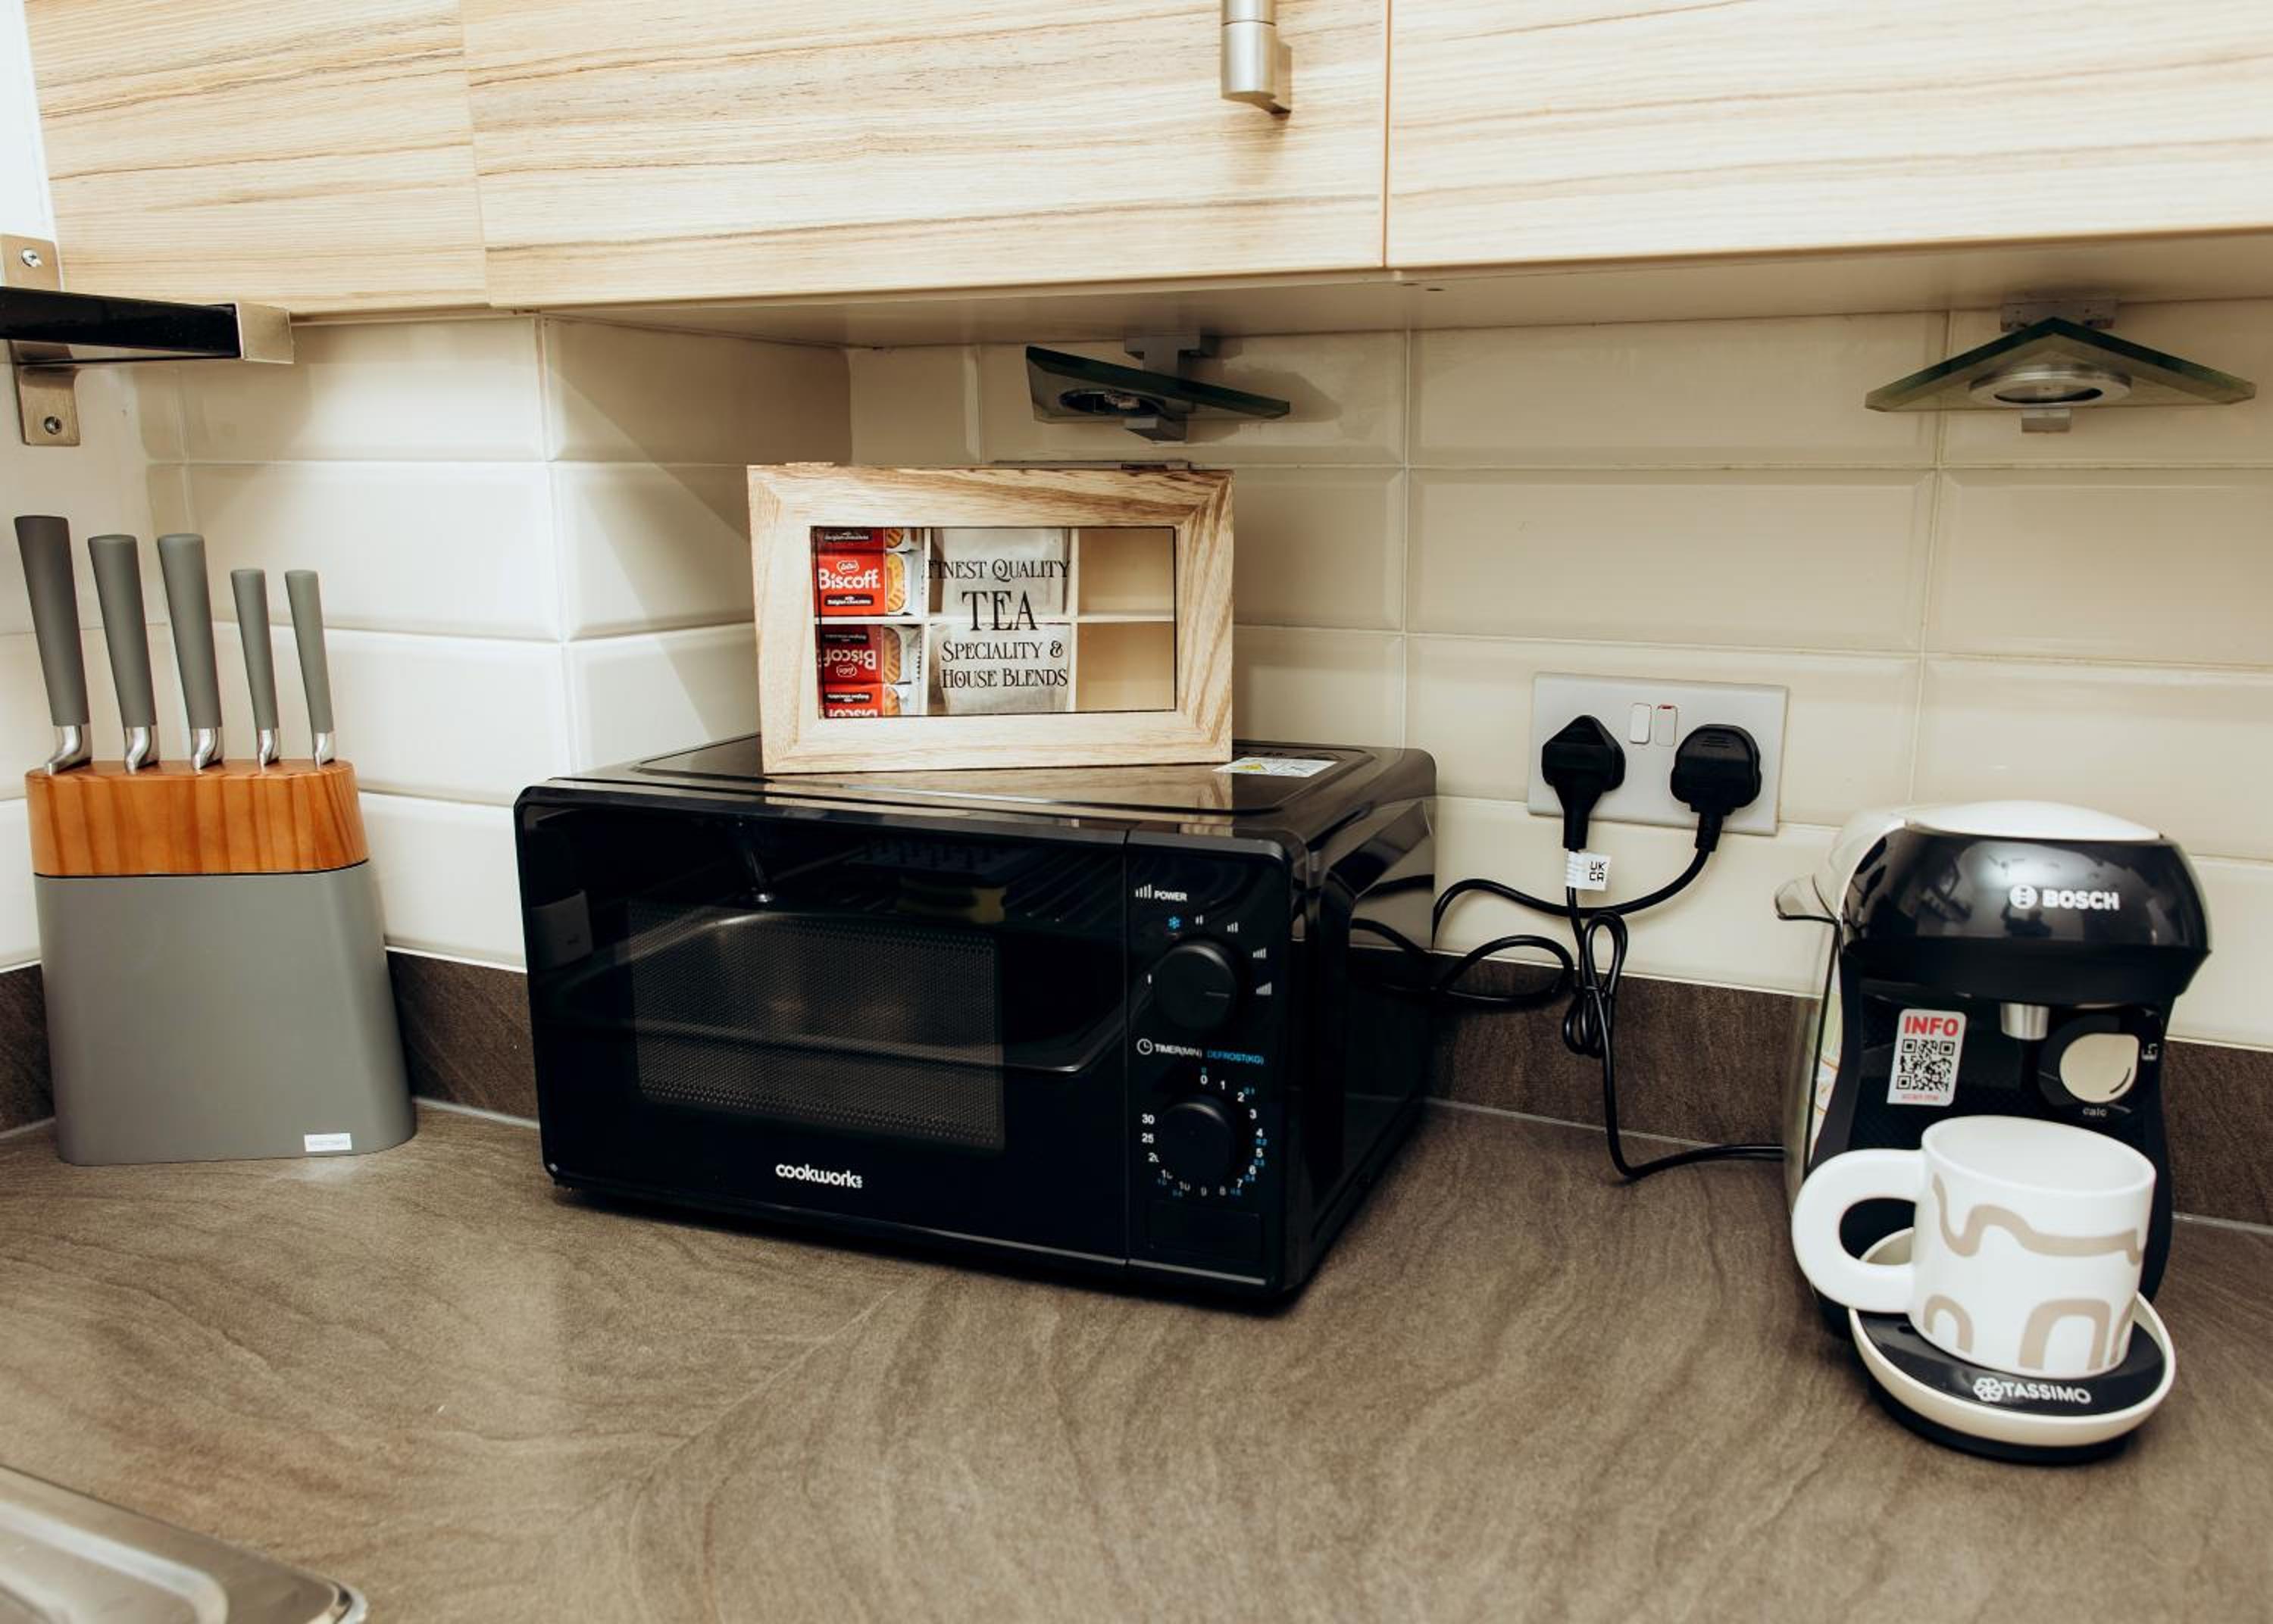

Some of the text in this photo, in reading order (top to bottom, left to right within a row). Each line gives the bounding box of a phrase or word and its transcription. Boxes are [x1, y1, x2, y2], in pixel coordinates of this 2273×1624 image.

[992, 559, 1070, 582] QUALITY
[961, 590, 1039, 631] TEA
[942, 640, 1063, 662] SPECIALITY &
[942, 668, 1068, 689] HOUSE BLENDS
[1590, 860, 1606, 871] UK
[1154, 890, 1187, 902] POWER
[2043, 889, 2120, 910] BOSCH
[1903, 1016, 1959, 1037] INFO
[1200, 1075, 1208, 1085] 0
[1220, 1080, 1226, 1090] 1
[1237, 1092, 1245, 1102] 2
[1142, 1113, 1155, 1125] 30
[1249, 1109, 1257, 1120] 3
[1142, 1132, 1154, 1144] 25
[1256, 1128, 1263, 1137] 4
[1255, 1148, 1263, 1157] 5
[1249, 1164, 1256, 1175] 6
[1237, 1178, 1243, 1188] 7
[2000, 1382, 2092, 1404] TASSIMO
